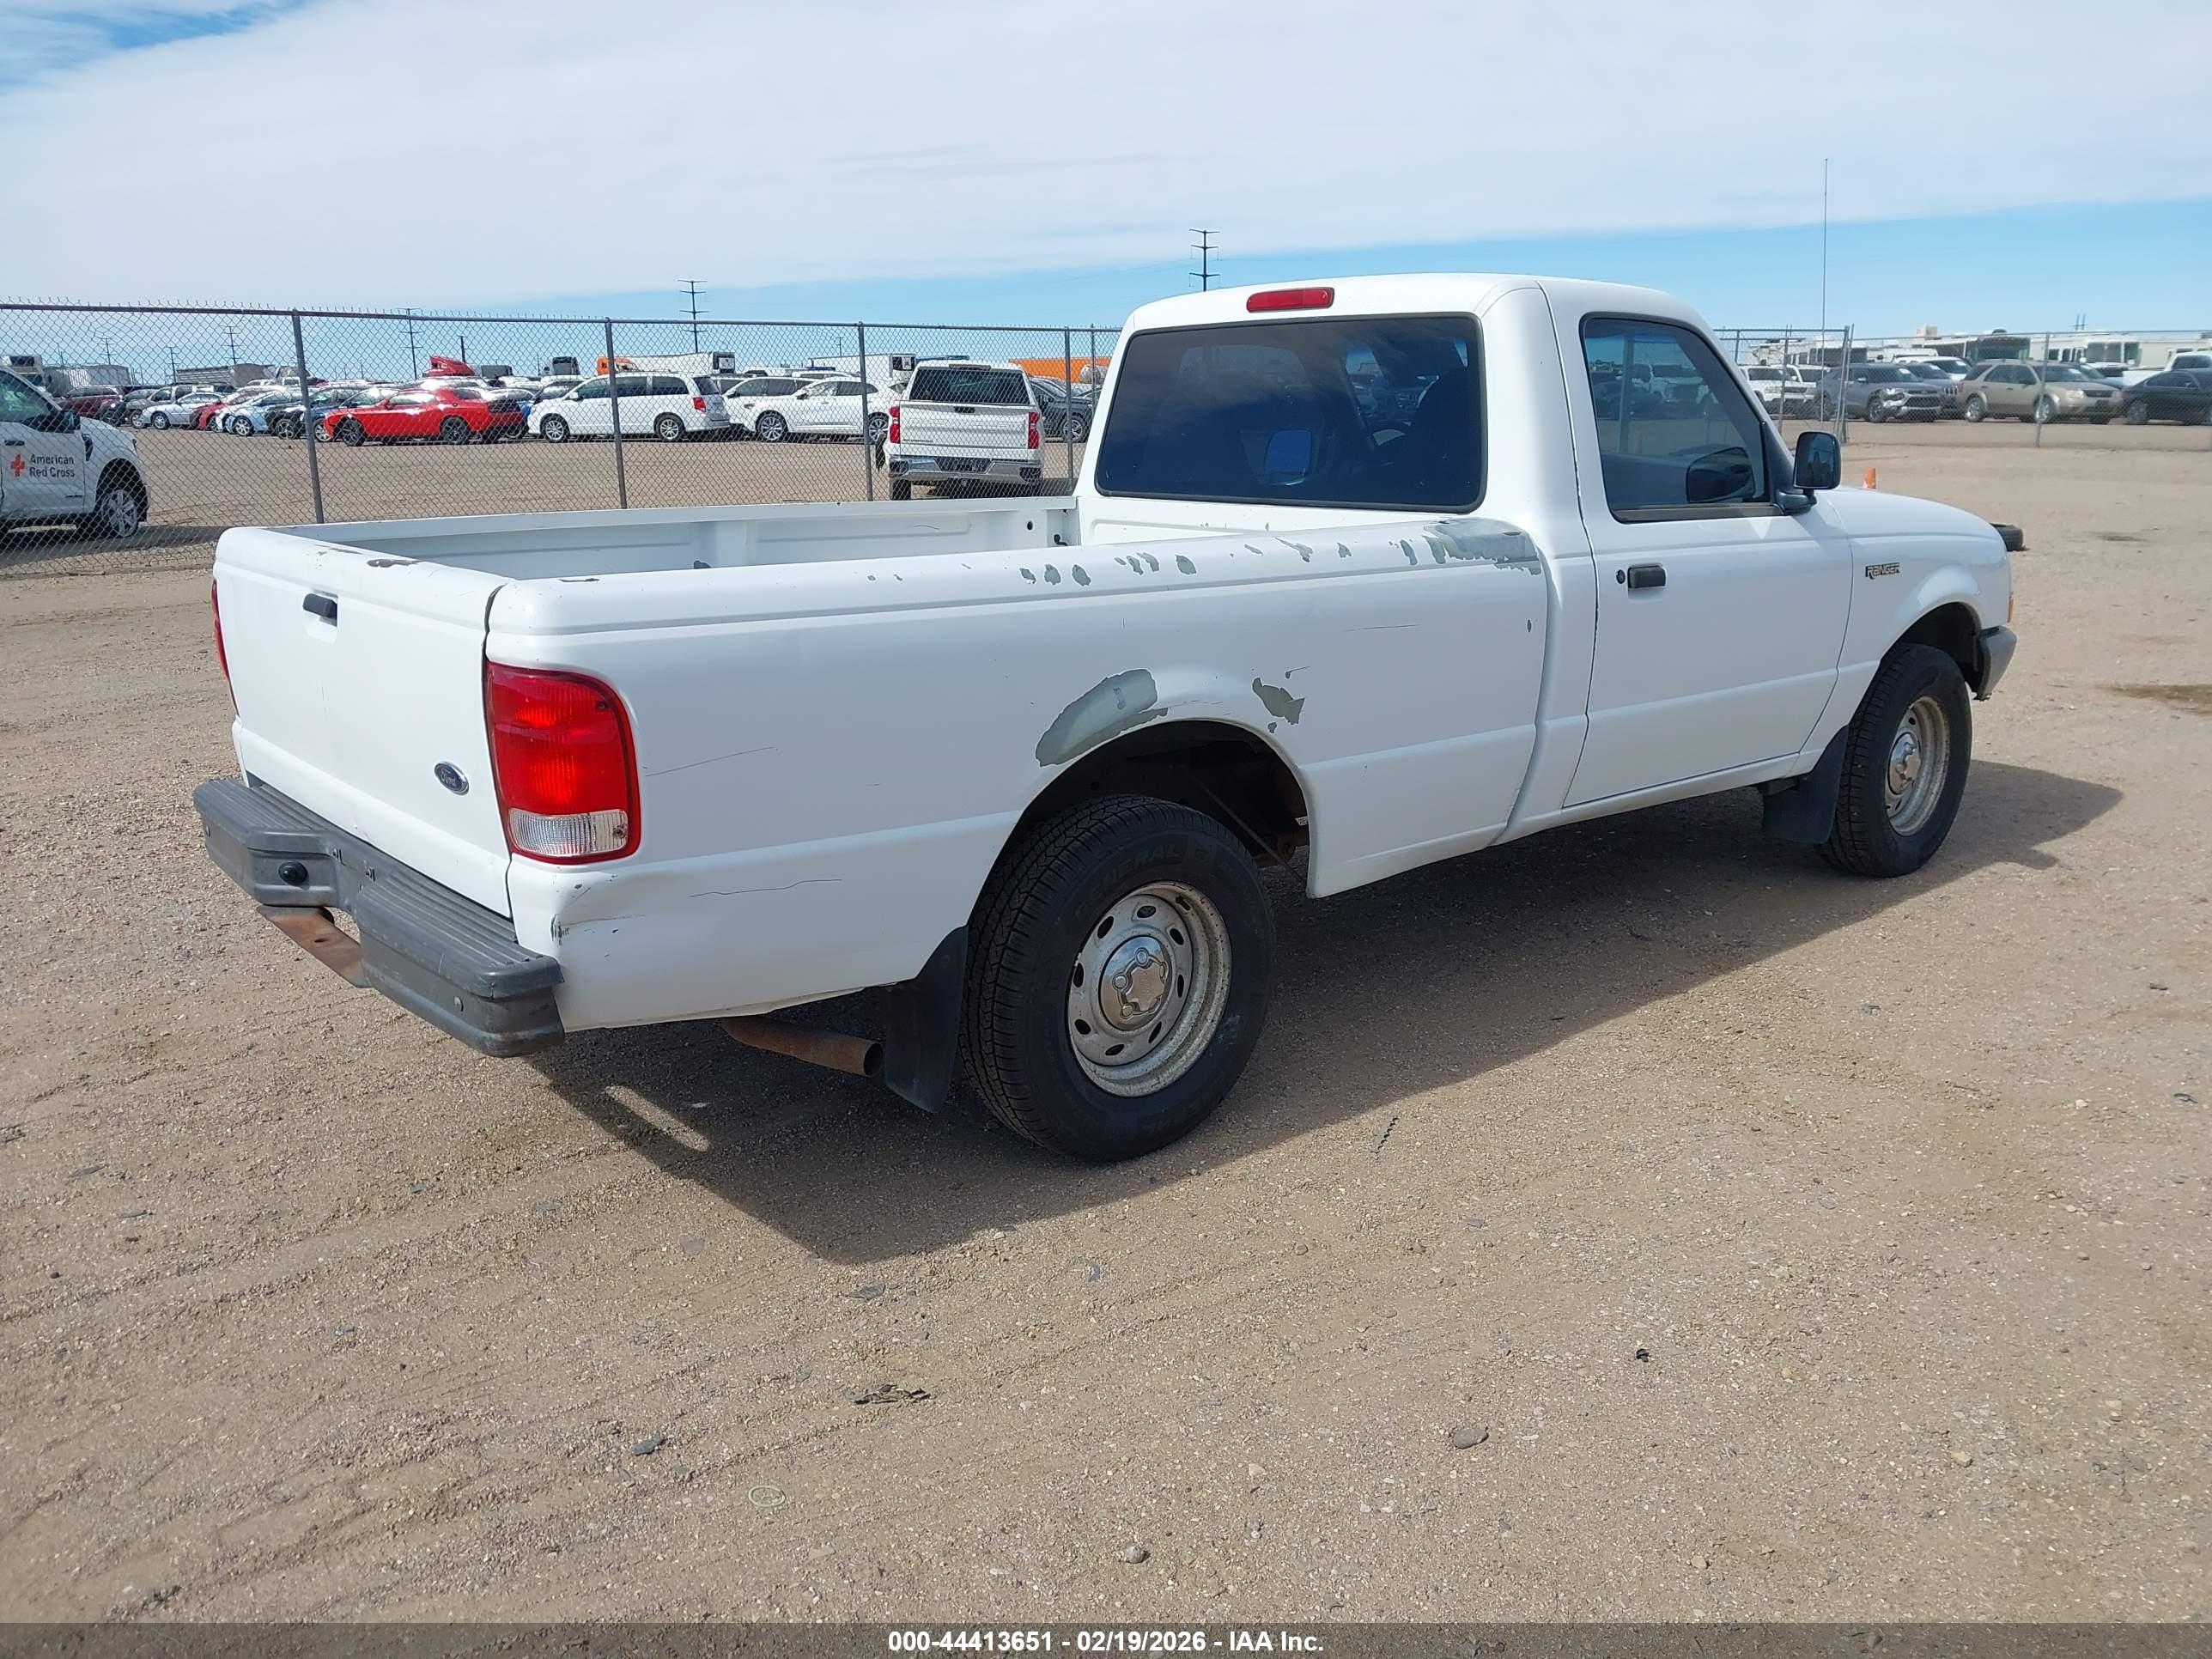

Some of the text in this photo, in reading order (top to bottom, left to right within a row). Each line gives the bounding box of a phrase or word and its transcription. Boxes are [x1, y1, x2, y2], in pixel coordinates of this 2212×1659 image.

[29, 453, 75, 465] American
[29, 466, 76, 478] Red Cross
